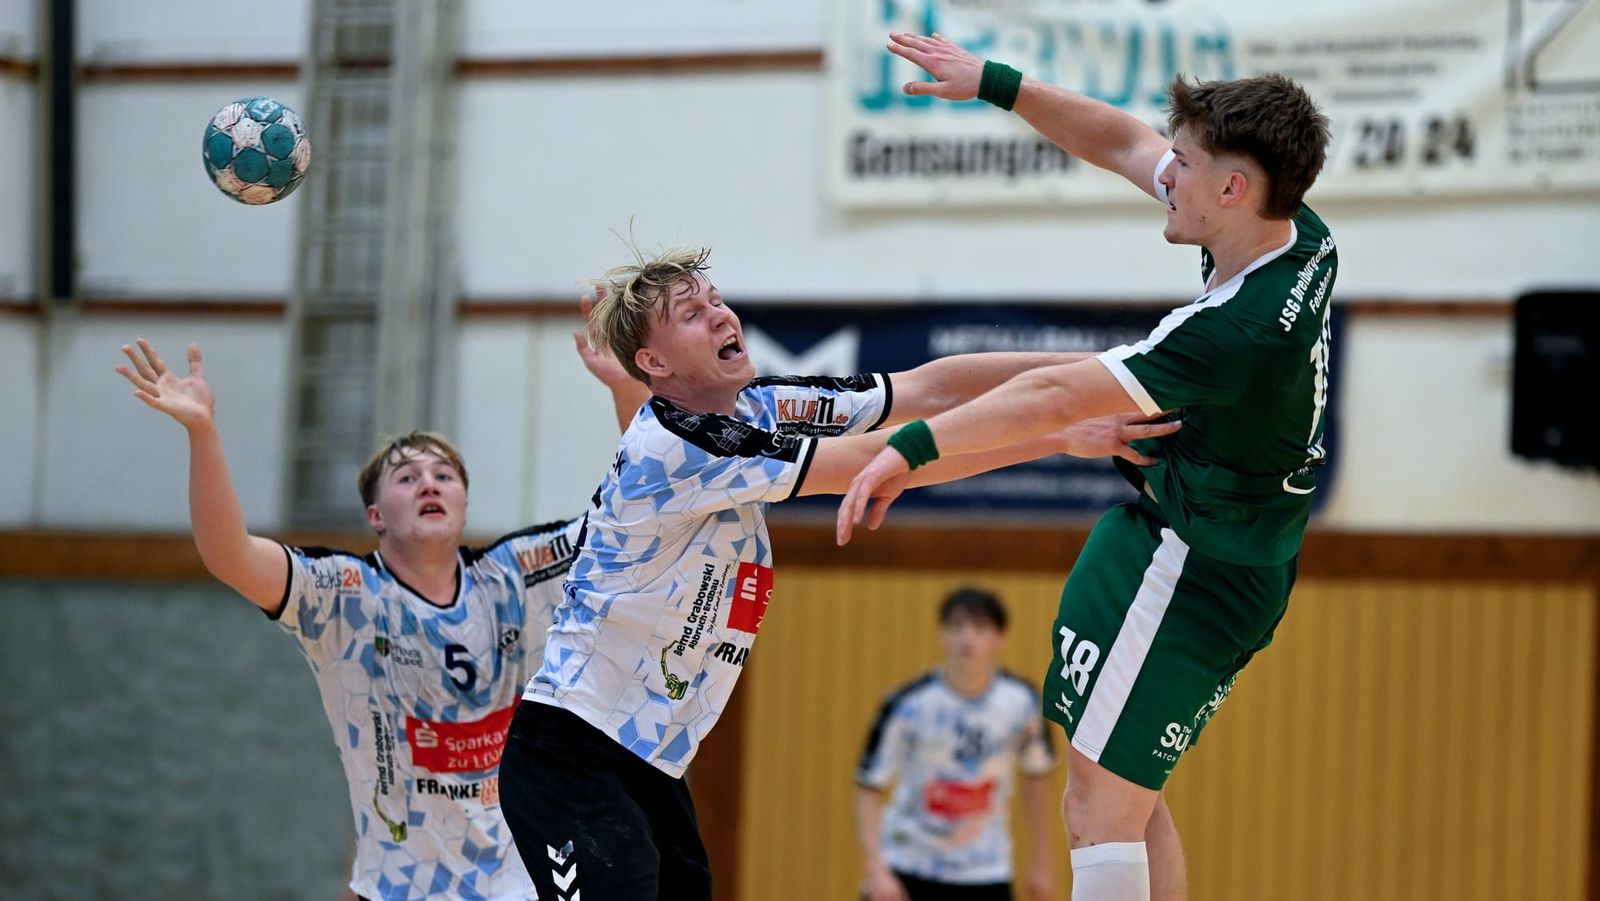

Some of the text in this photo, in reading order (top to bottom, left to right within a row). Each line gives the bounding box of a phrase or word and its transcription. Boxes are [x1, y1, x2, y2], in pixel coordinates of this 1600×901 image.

[1278, 298, 1301, 332] JSG
[674, 563, 715, 657] Bernd Grabowski
[445, 644, 477, 692] 5
[1059, 625, 1101, 697] 18
[448, 757, 469, 769] zu
